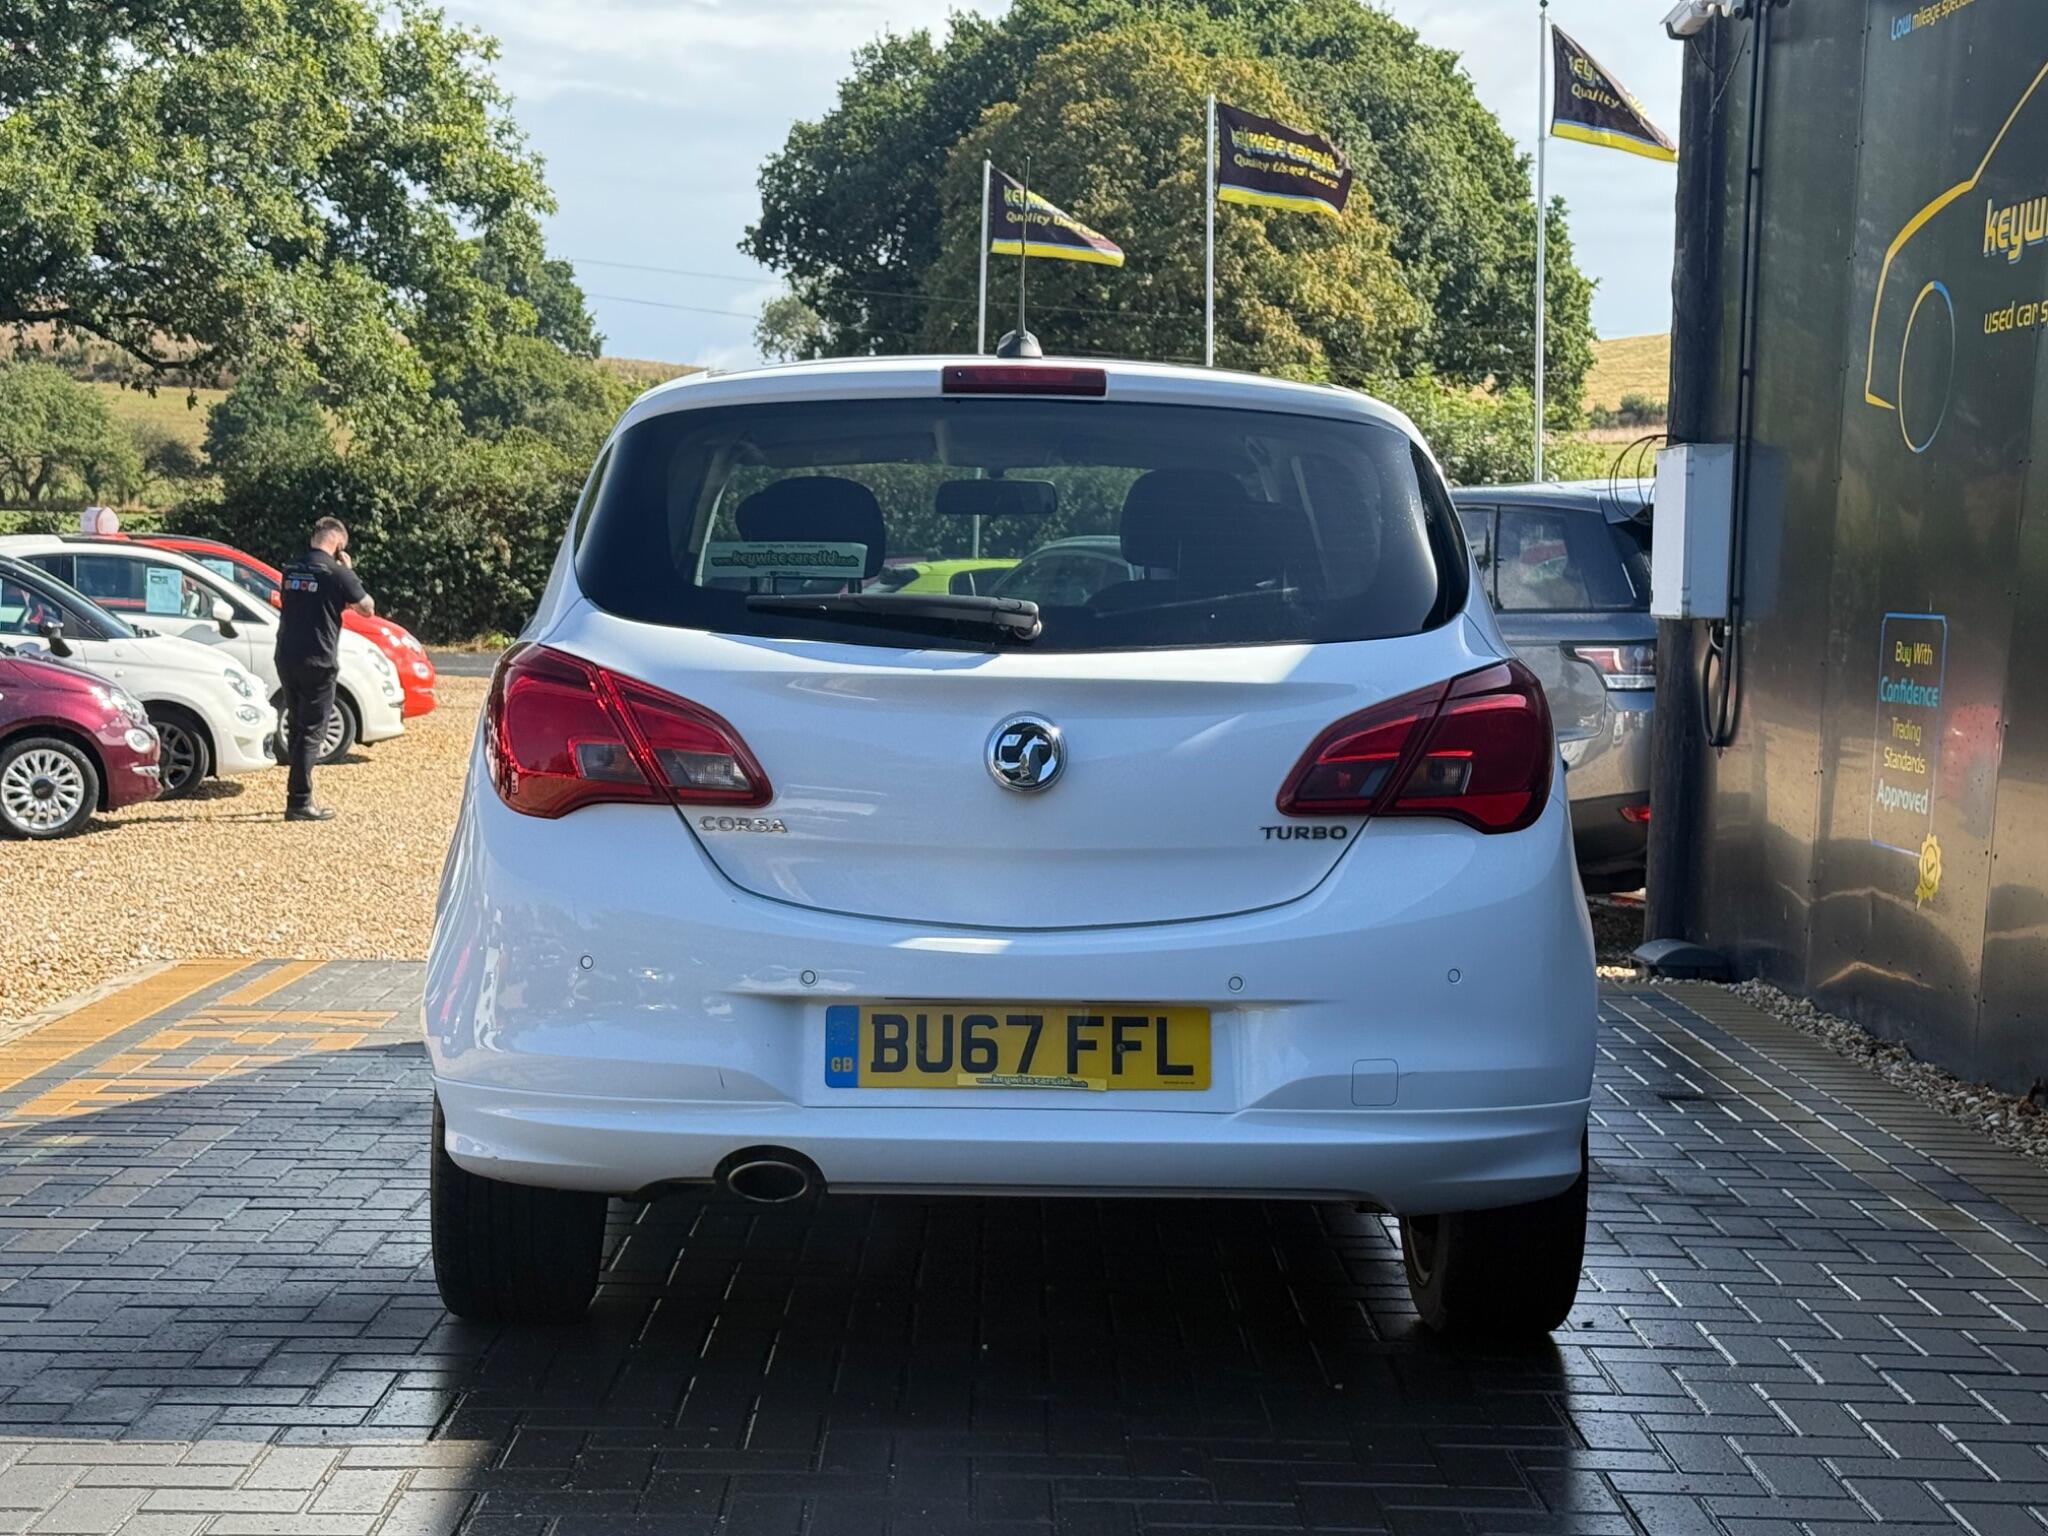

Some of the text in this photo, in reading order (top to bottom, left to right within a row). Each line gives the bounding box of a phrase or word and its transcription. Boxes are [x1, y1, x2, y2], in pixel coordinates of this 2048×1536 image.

[1890, 13, 1912, 41] Low
[1911, 5, 1941, 32] mileage
[1570, 82, 1620, 109] Quality
[1233, 153, 1340, 190] Quality Used Cars
[1005, 211, 1050, 226] Quality
[1983, 196, 2048, 265] keyw
[1983, 301, 2016, 335] used
[2016, 303, 2039, 328] car
[1895, 641, 1933, 668] Buy With
[1880, 676, 1939, 707] Confidence
[1892, 717, 1922, 747] Trading
[1883, 747, 1926, 775] Standards
[1876, 778, 1929, 816] Approved
[699, 816, 788, 833] CORSA
[1259, 825, 1348, 841] TURBO
[870, 1013, 1194, 1076] BU67 FFL
[830, 1057, 853, 1073] GB
